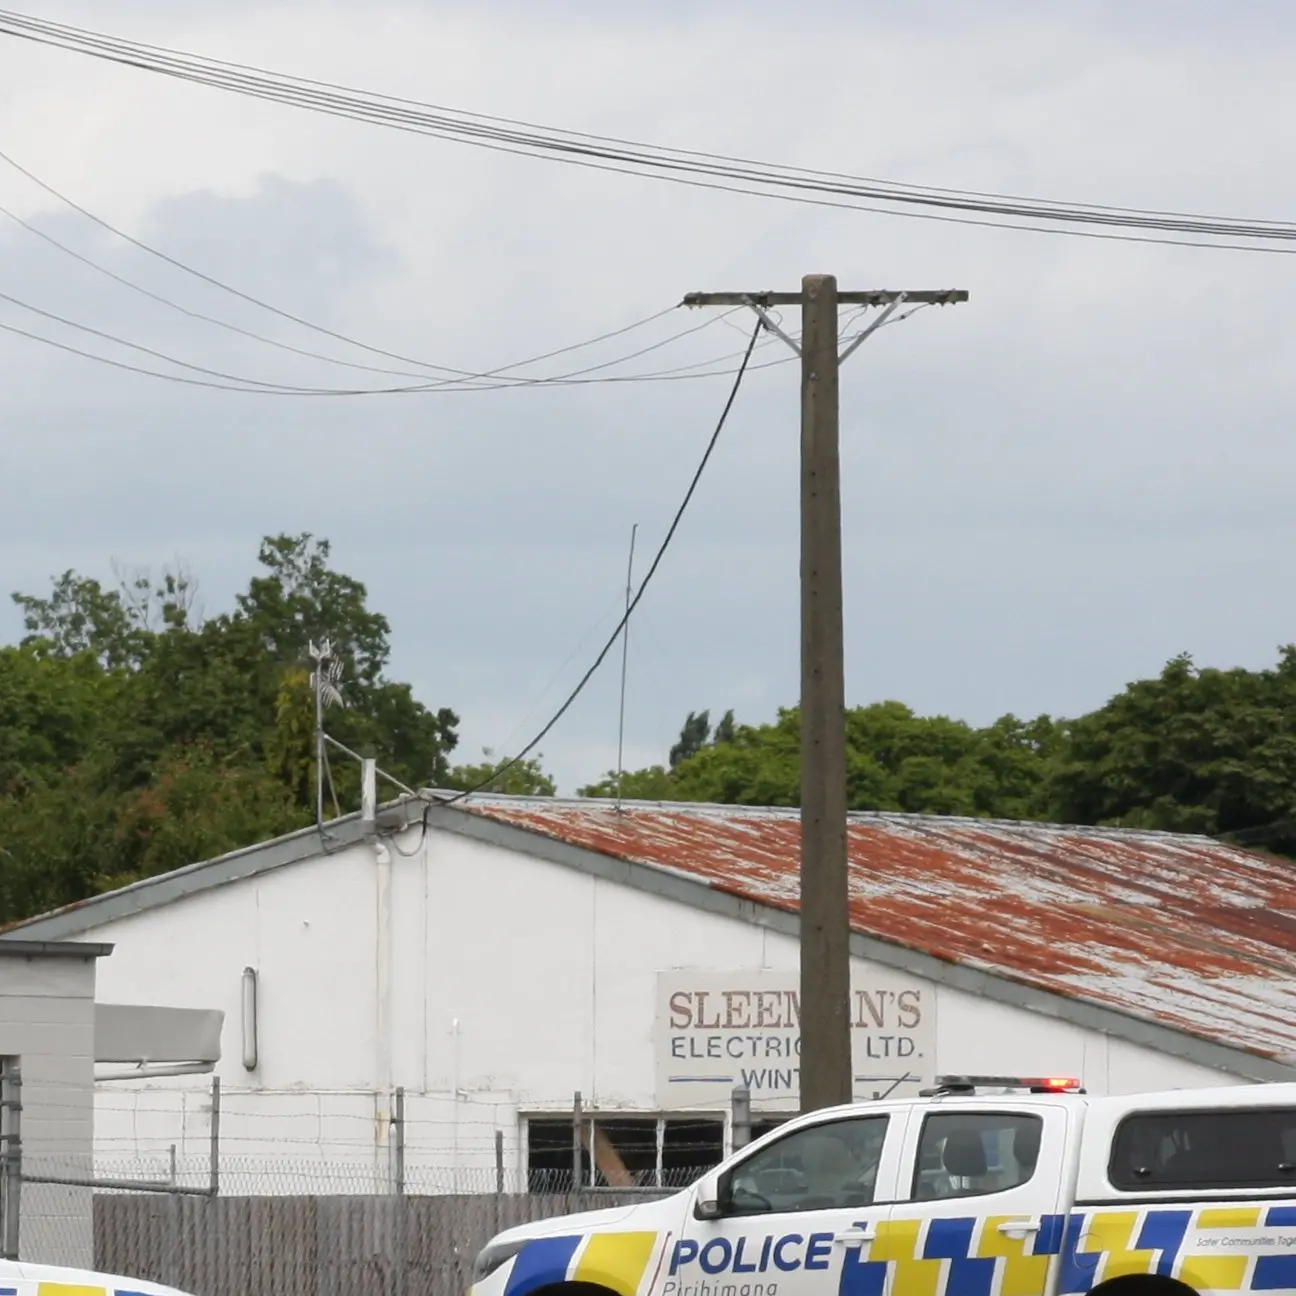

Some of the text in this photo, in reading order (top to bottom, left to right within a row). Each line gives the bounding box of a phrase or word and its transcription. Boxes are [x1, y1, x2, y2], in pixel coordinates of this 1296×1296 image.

[669, 990, 922, 1030] SLEEN'S
[866, 1036, 923, 1058] LTD.
[667, 1232, 835, 1276] POLICE
